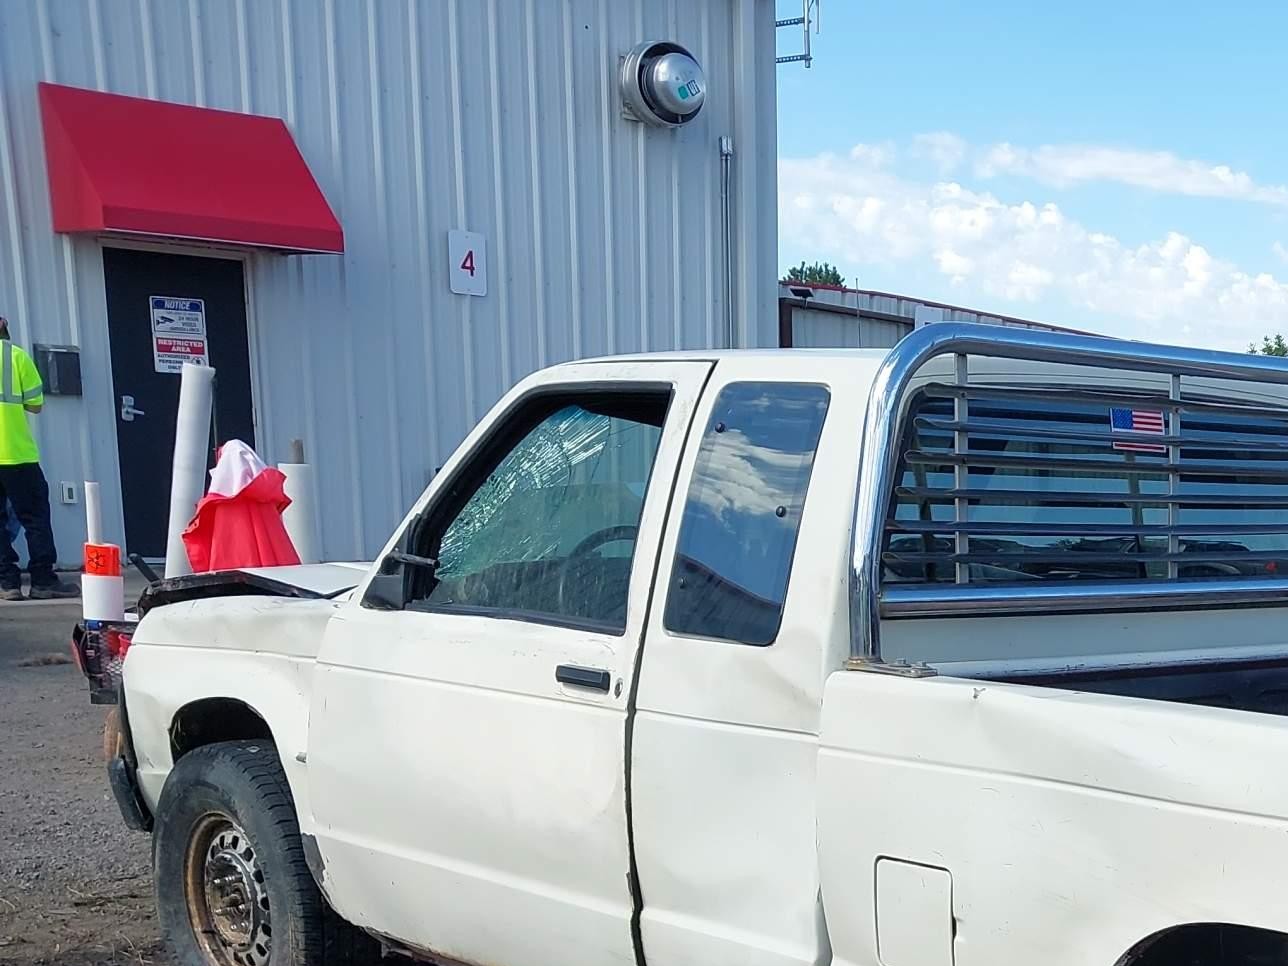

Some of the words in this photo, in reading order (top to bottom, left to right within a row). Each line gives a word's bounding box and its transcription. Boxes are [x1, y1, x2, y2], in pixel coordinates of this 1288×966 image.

[460, 249, 476, 278] 4
[164, 300, 190, 310] NOTICE
[158, 339, 203, 347] RESTRICTED
[171, 345, 192, 353] AREA
